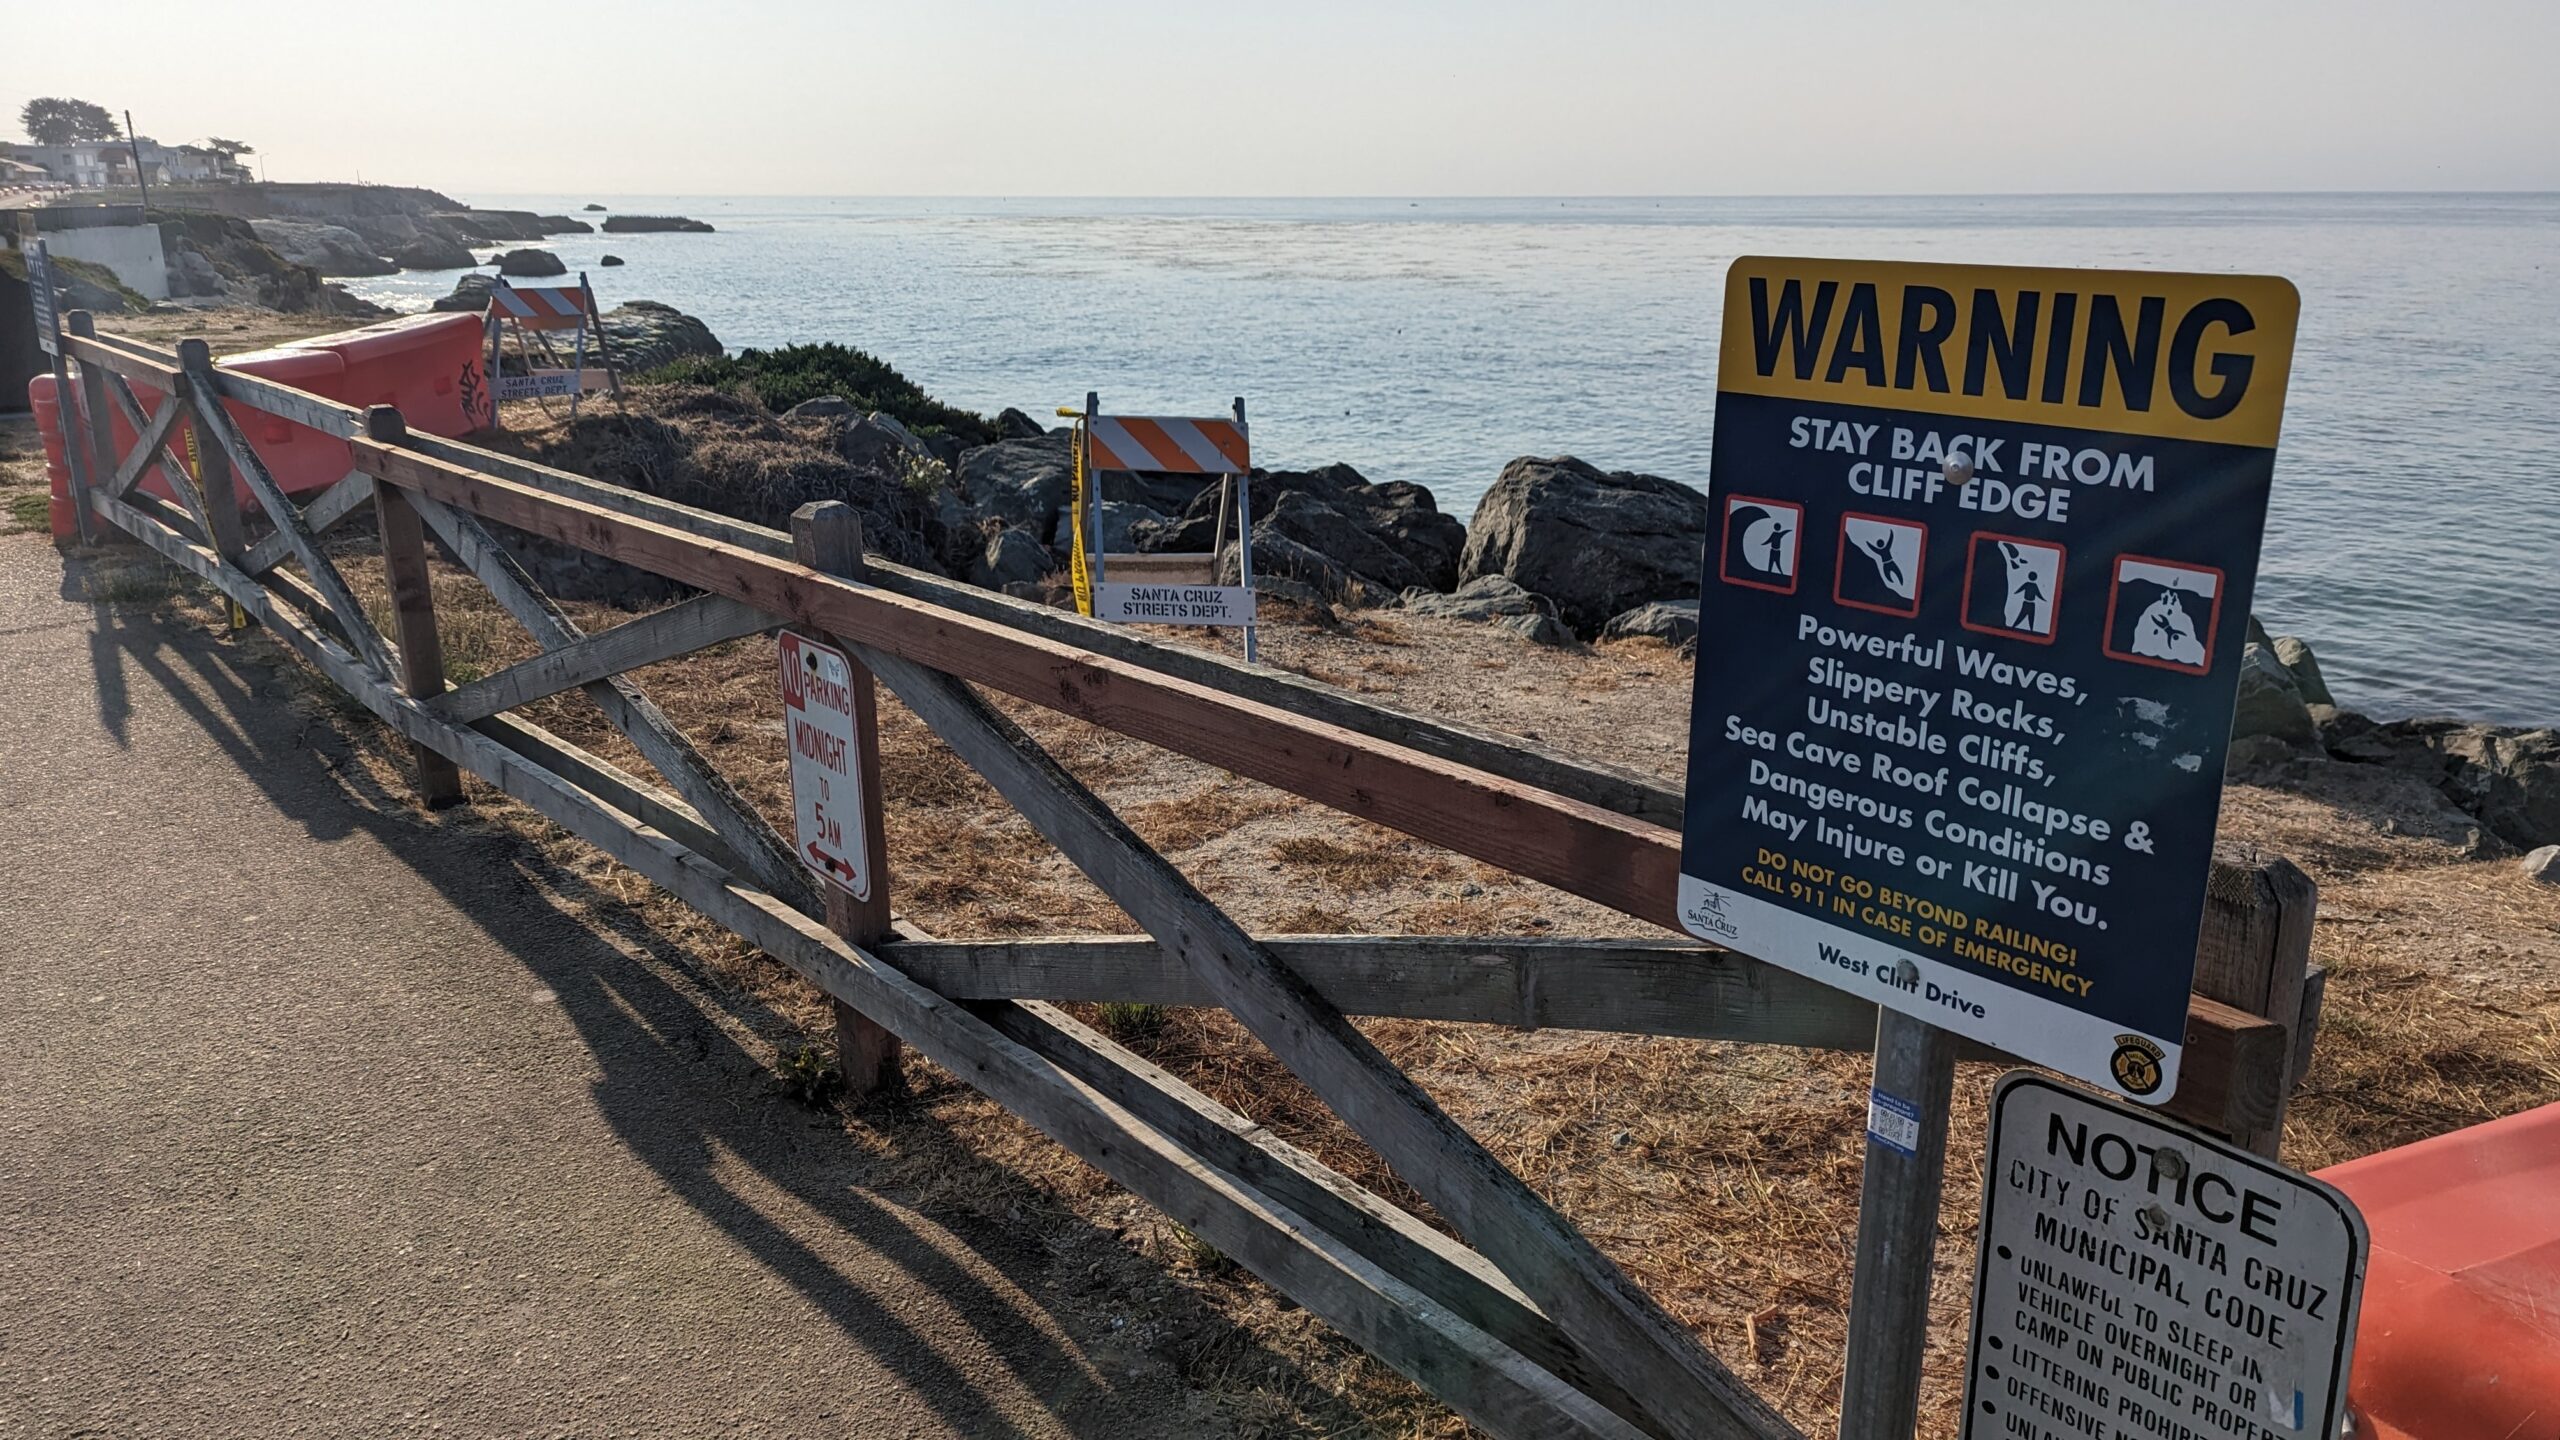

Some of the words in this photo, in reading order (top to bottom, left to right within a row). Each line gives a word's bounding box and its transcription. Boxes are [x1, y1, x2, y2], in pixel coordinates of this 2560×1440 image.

[501, 387, 540, 399] STREETS
[505, 377, 536, 388] SANTA
[540, 375, 565, 385] CRUZ
[1749, 277, 2256, 420] WARNING
[1789, 416, 1879, 455] STAY
[1891, 427, 2005, 472] BACK
[2019, 442, 2154, 492] FROM
[1848, 463, 1946, 504] CLIFF
[1959, 477, 2071, 523] EDGE
[1123, 602, 1188, 617] STREETS
[1192, 605, 1232, 618] DEPT.
[1131, 587, 1180, 601] SANTA
[1184, 590, 1223, 603] CRUZ
[781, 646, 801, 698] NO
[803, 671, 850, 716] PARKING
[1799, 614, 1944, 670] Powerful
[1956, 646, 2088, 706] Waves,
[1808, 656, 1941, 718] Slippery
[1952, 688, 2066, 745] Rocks,
[795, 717, 847, 776] MIDNIGHT
[1725, 715, 1777, 752] Sea
[1786, 731, 1861, 773] Cave
[1872, 752, 1949, 796] Roof
[1958, 776, 2111, 841] Collapse
[2124, 821, 2155, 855] &
[1808, 696, 1947, 755] Unstable
[1959, 735, 2056, 787] Cliffs,
[815, 801, 826, 839] 5
[828, 817, 842, 850] AM
[819, 776, 829, 801] TO
[1749, 759, 1913, 828] Dangerous
[1924, 809, 2111, 886] Conditions
[1742, 796, 1807, 842] May
[1816, 816, 1906, 867] Injure
[1916, 854, 1952, 880] or
[1963, 861, 2018, 902] Kill
[2030, 879, 2108, 930] You.
[1758, 848, 1787, 871] DO
[1793, 859, 1836, 887] NOT
[1840, 874, 1873, 899] GO
[1880, 886, 1967, 931] BEYOND
[1975, 917, 2078, 968] RAILING!
[1688, 909, 1713, 927] SANTA
[1715, 918, 1738, 935] CRUZ
[1742, 867, 1784, 895] CALL
[1790, 882, 1825, 908] 911
[1833, 896, 1856, 918] IN
[1861, 906, 1911, 938] CASE
[1918, 925, 1948, 949] OF
[1954, 937, 2095, 998] EMERGENCY
[1818, 942, 1869, 976] West
[1926, 982, 1985, 1018] Drive
[2116, 1036, 2161, 1058] LIFEGUARD
[2047, 1112, 2282, 1248] NOTICE
[2010, 1159, 2070, 1206] CITY
[2083, 1189, 2119, 1225] OF
[2134, 1208, 2228, 1276] SANTA
[2244, 1256, 2328, 1321] CRUZ
[2035, 1212, 2190, 1306] MUNICIPAL
[2204, 1287, 2285, 1350] CODE
[2018, 1281, 2096, 1334] VEHICLE
[2105, 1322, 2221, 1393] OVERNIGHT
[2229, 1382, 2257, 1413] OR
[2021, 1255, 2124, 1319] UNLAWFUL
[2134, 1303, 2158, 1333] TO
[2168, 1320, 2233, 1367] SLEEP
[2242, 1355, 2263, 1384] IN
[2007, 1376, 2106, 1440] OFFENSIVE
[2012, 1344, 2109, 1409] LITTERING
[2118, 1396, 2209, 1440] PROHIB
[2015, 1310, 2069, 1350] CAMP
[2077, 1339, 2103, 1368] ON
[2112, 1355, 2183, 1407] PUBLIC
[2192, 1395, 2287, 1440] PROPER
